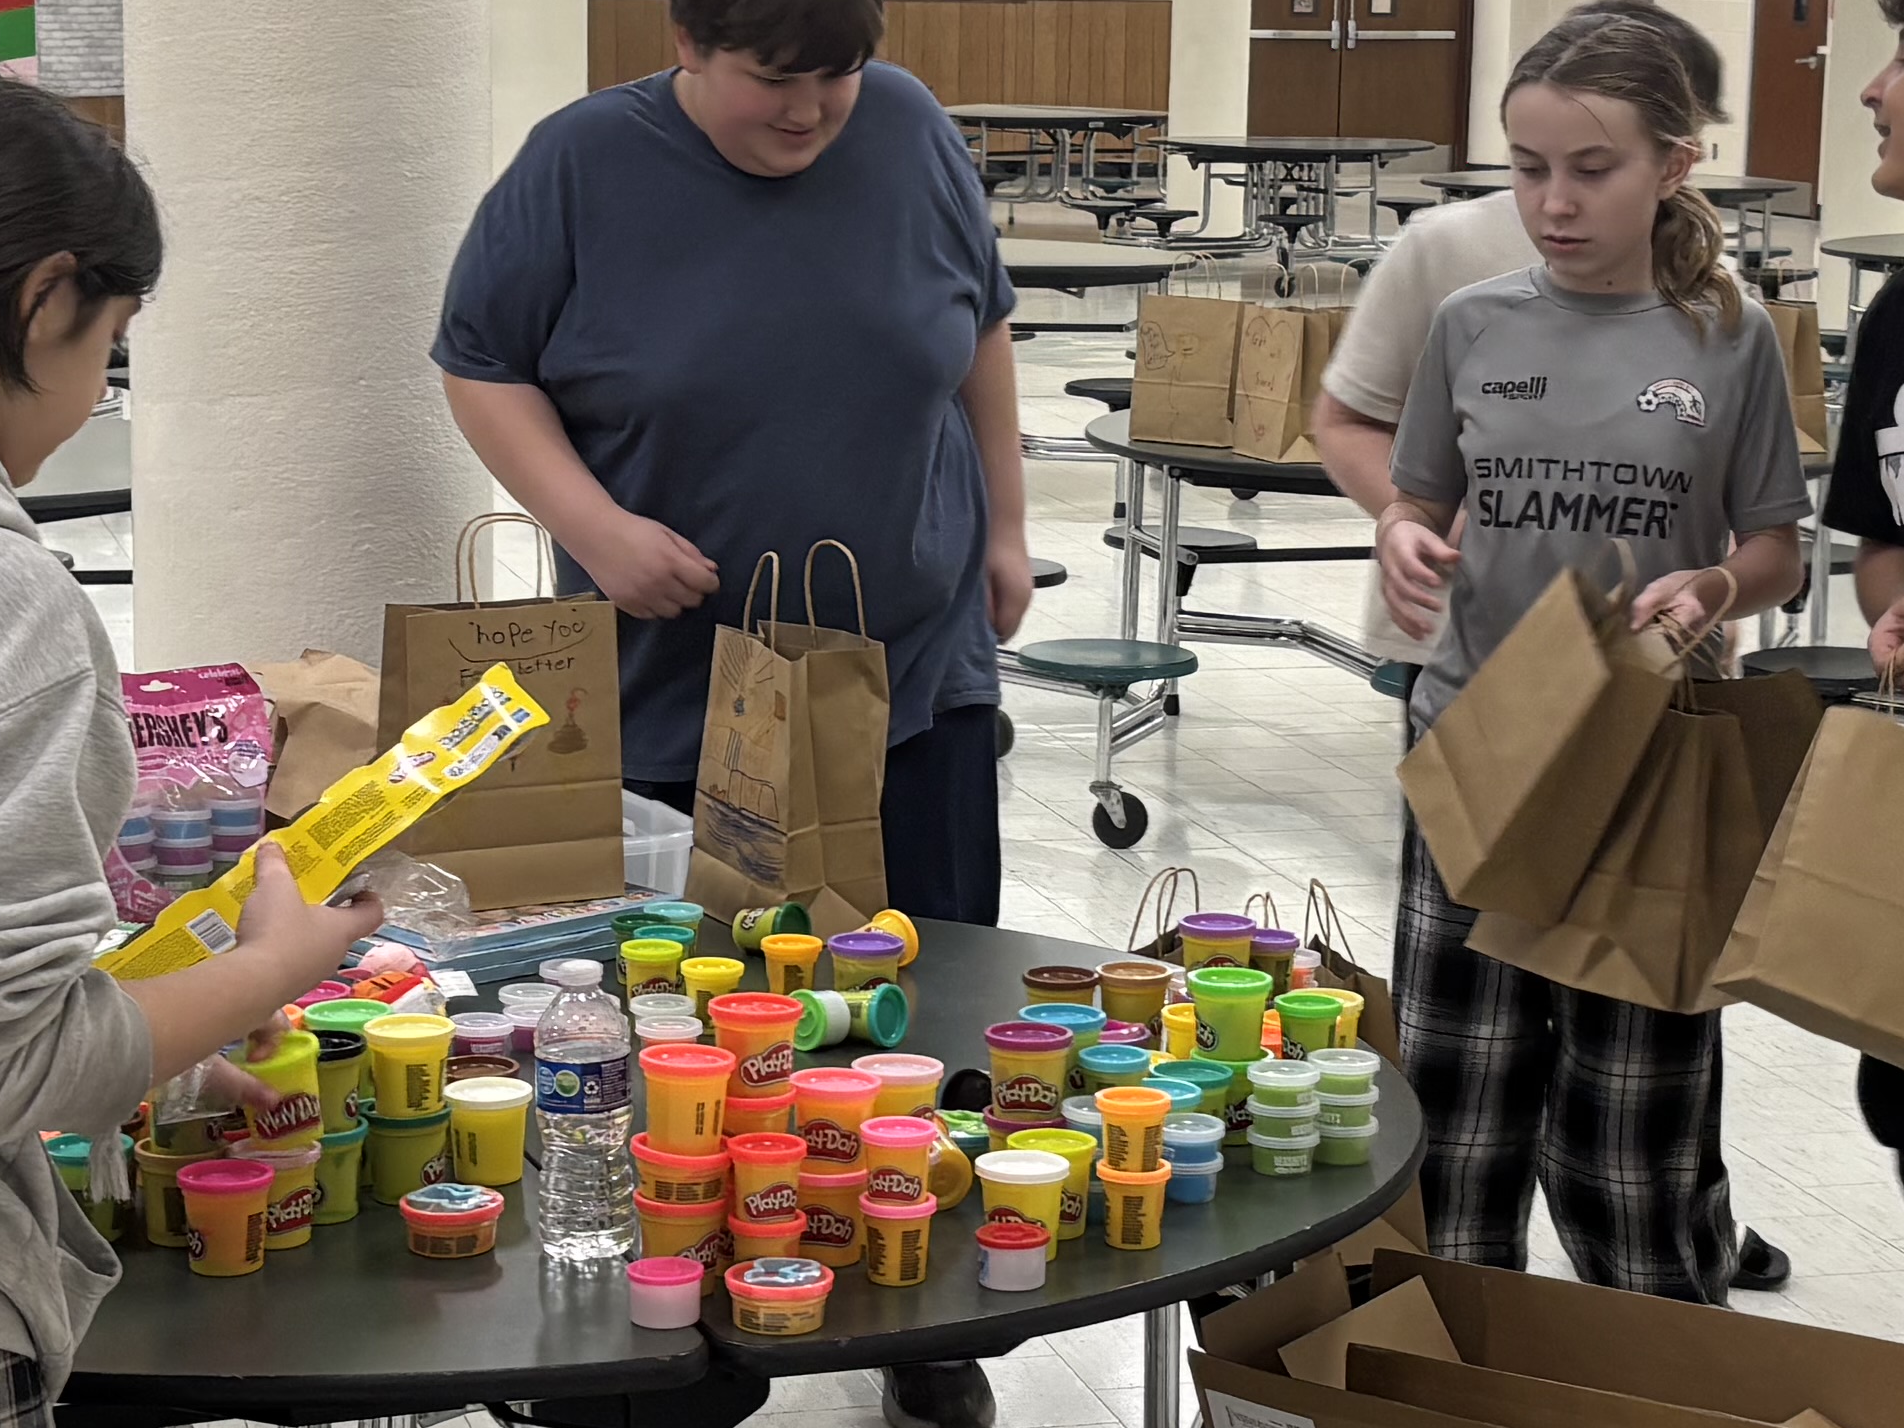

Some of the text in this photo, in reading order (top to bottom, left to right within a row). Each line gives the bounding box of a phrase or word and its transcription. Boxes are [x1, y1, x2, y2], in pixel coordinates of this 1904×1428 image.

[1481, 376, 1548, 400] capelli
[1474, 457, 1693, 494] SMITHTOWN
[129, 707, 229, 749] ERSHEY'S
[806, 1129, 859, 1156] ay-Doh
[746, 1189, 797, 1215] Play-Do
